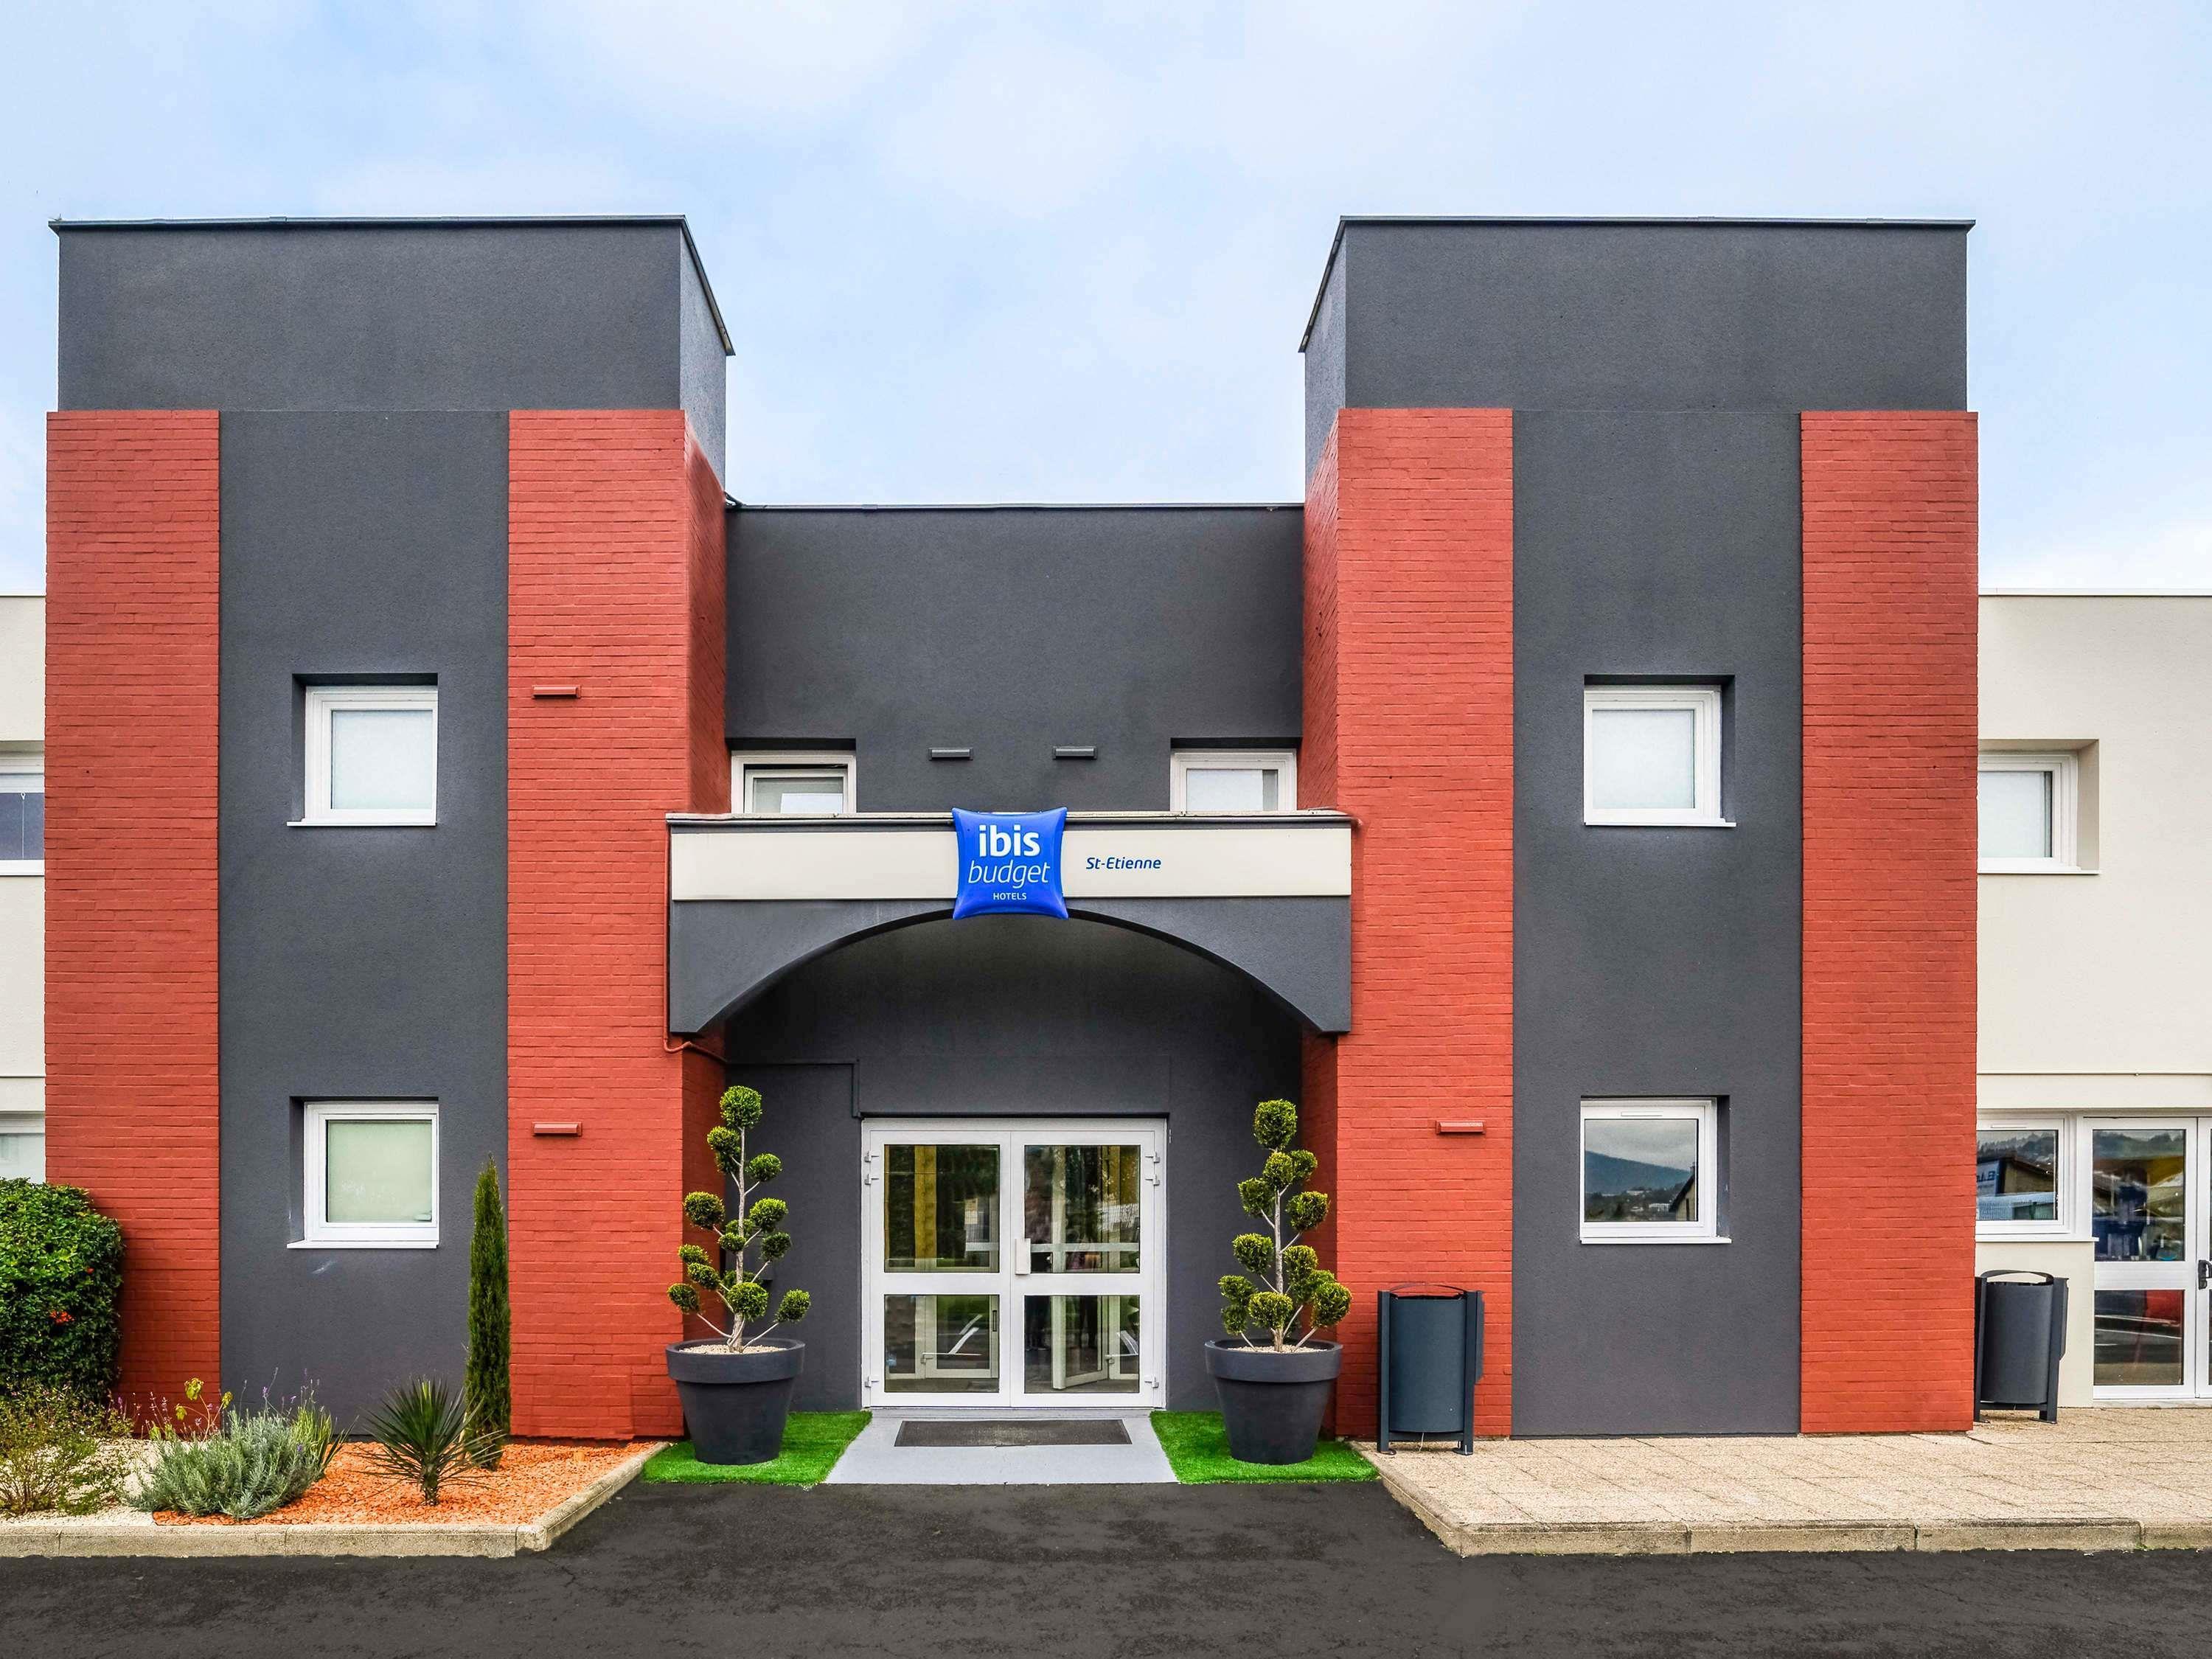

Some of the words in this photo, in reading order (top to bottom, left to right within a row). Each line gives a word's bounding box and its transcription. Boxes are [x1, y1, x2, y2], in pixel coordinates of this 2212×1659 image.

[978, 824, 1040, 857] ibis
[1085, 856, 1162, 870] St-Etienne
[967, 860, 1050, 888] budget
[992, 892, 1027, 900] HOTELS
